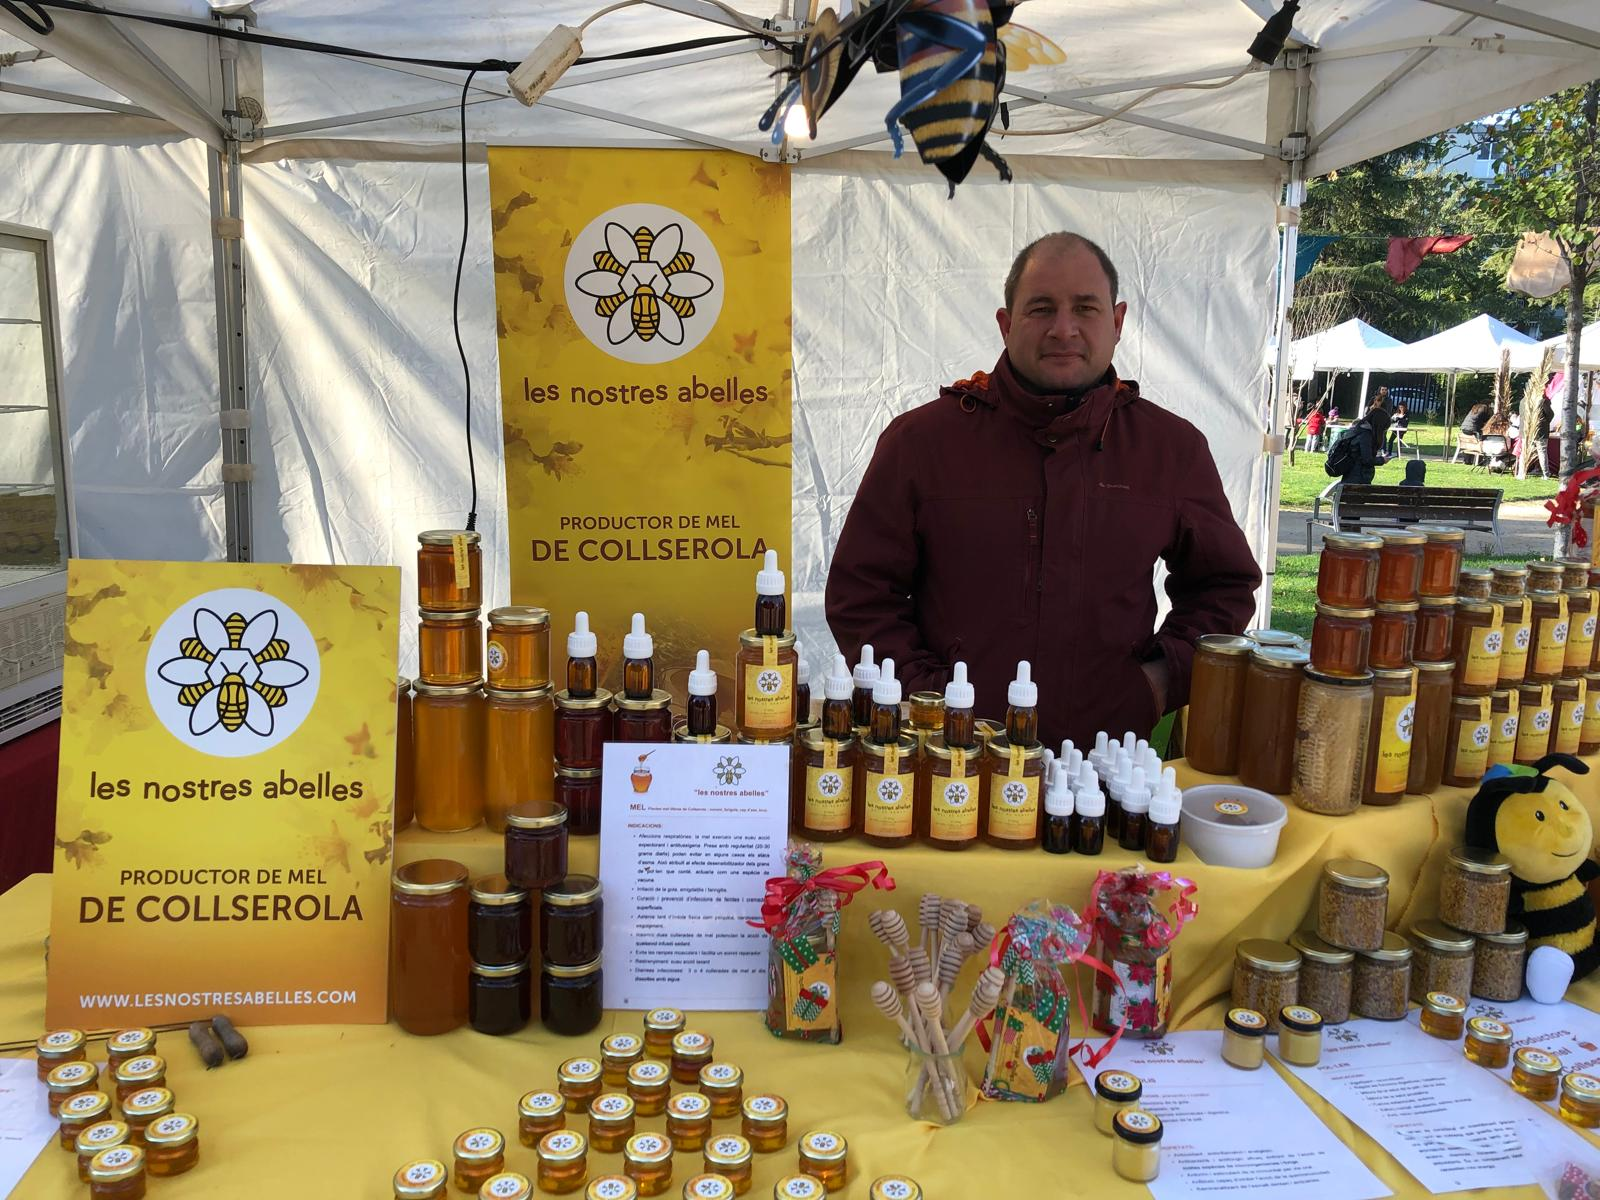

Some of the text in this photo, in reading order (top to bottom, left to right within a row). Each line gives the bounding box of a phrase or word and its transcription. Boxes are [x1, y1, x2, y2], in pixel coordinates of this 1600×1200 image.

[524, 375, 768, 406] les nostres abelles
[560, 515, 741, 530] PRODUCTOR DE MEL
[531, 537, 769, 562] DE COLLSEROLA
[90, 769, 364, 803] les nostres abelles
[120, 868, 327, 886] PRODUCTOR DE MEL
[79, 894, 364, 924] DE COLLSEROLA
[79, 990, 357, 1009] WWW.LESNOSTRESABELLES.COM
